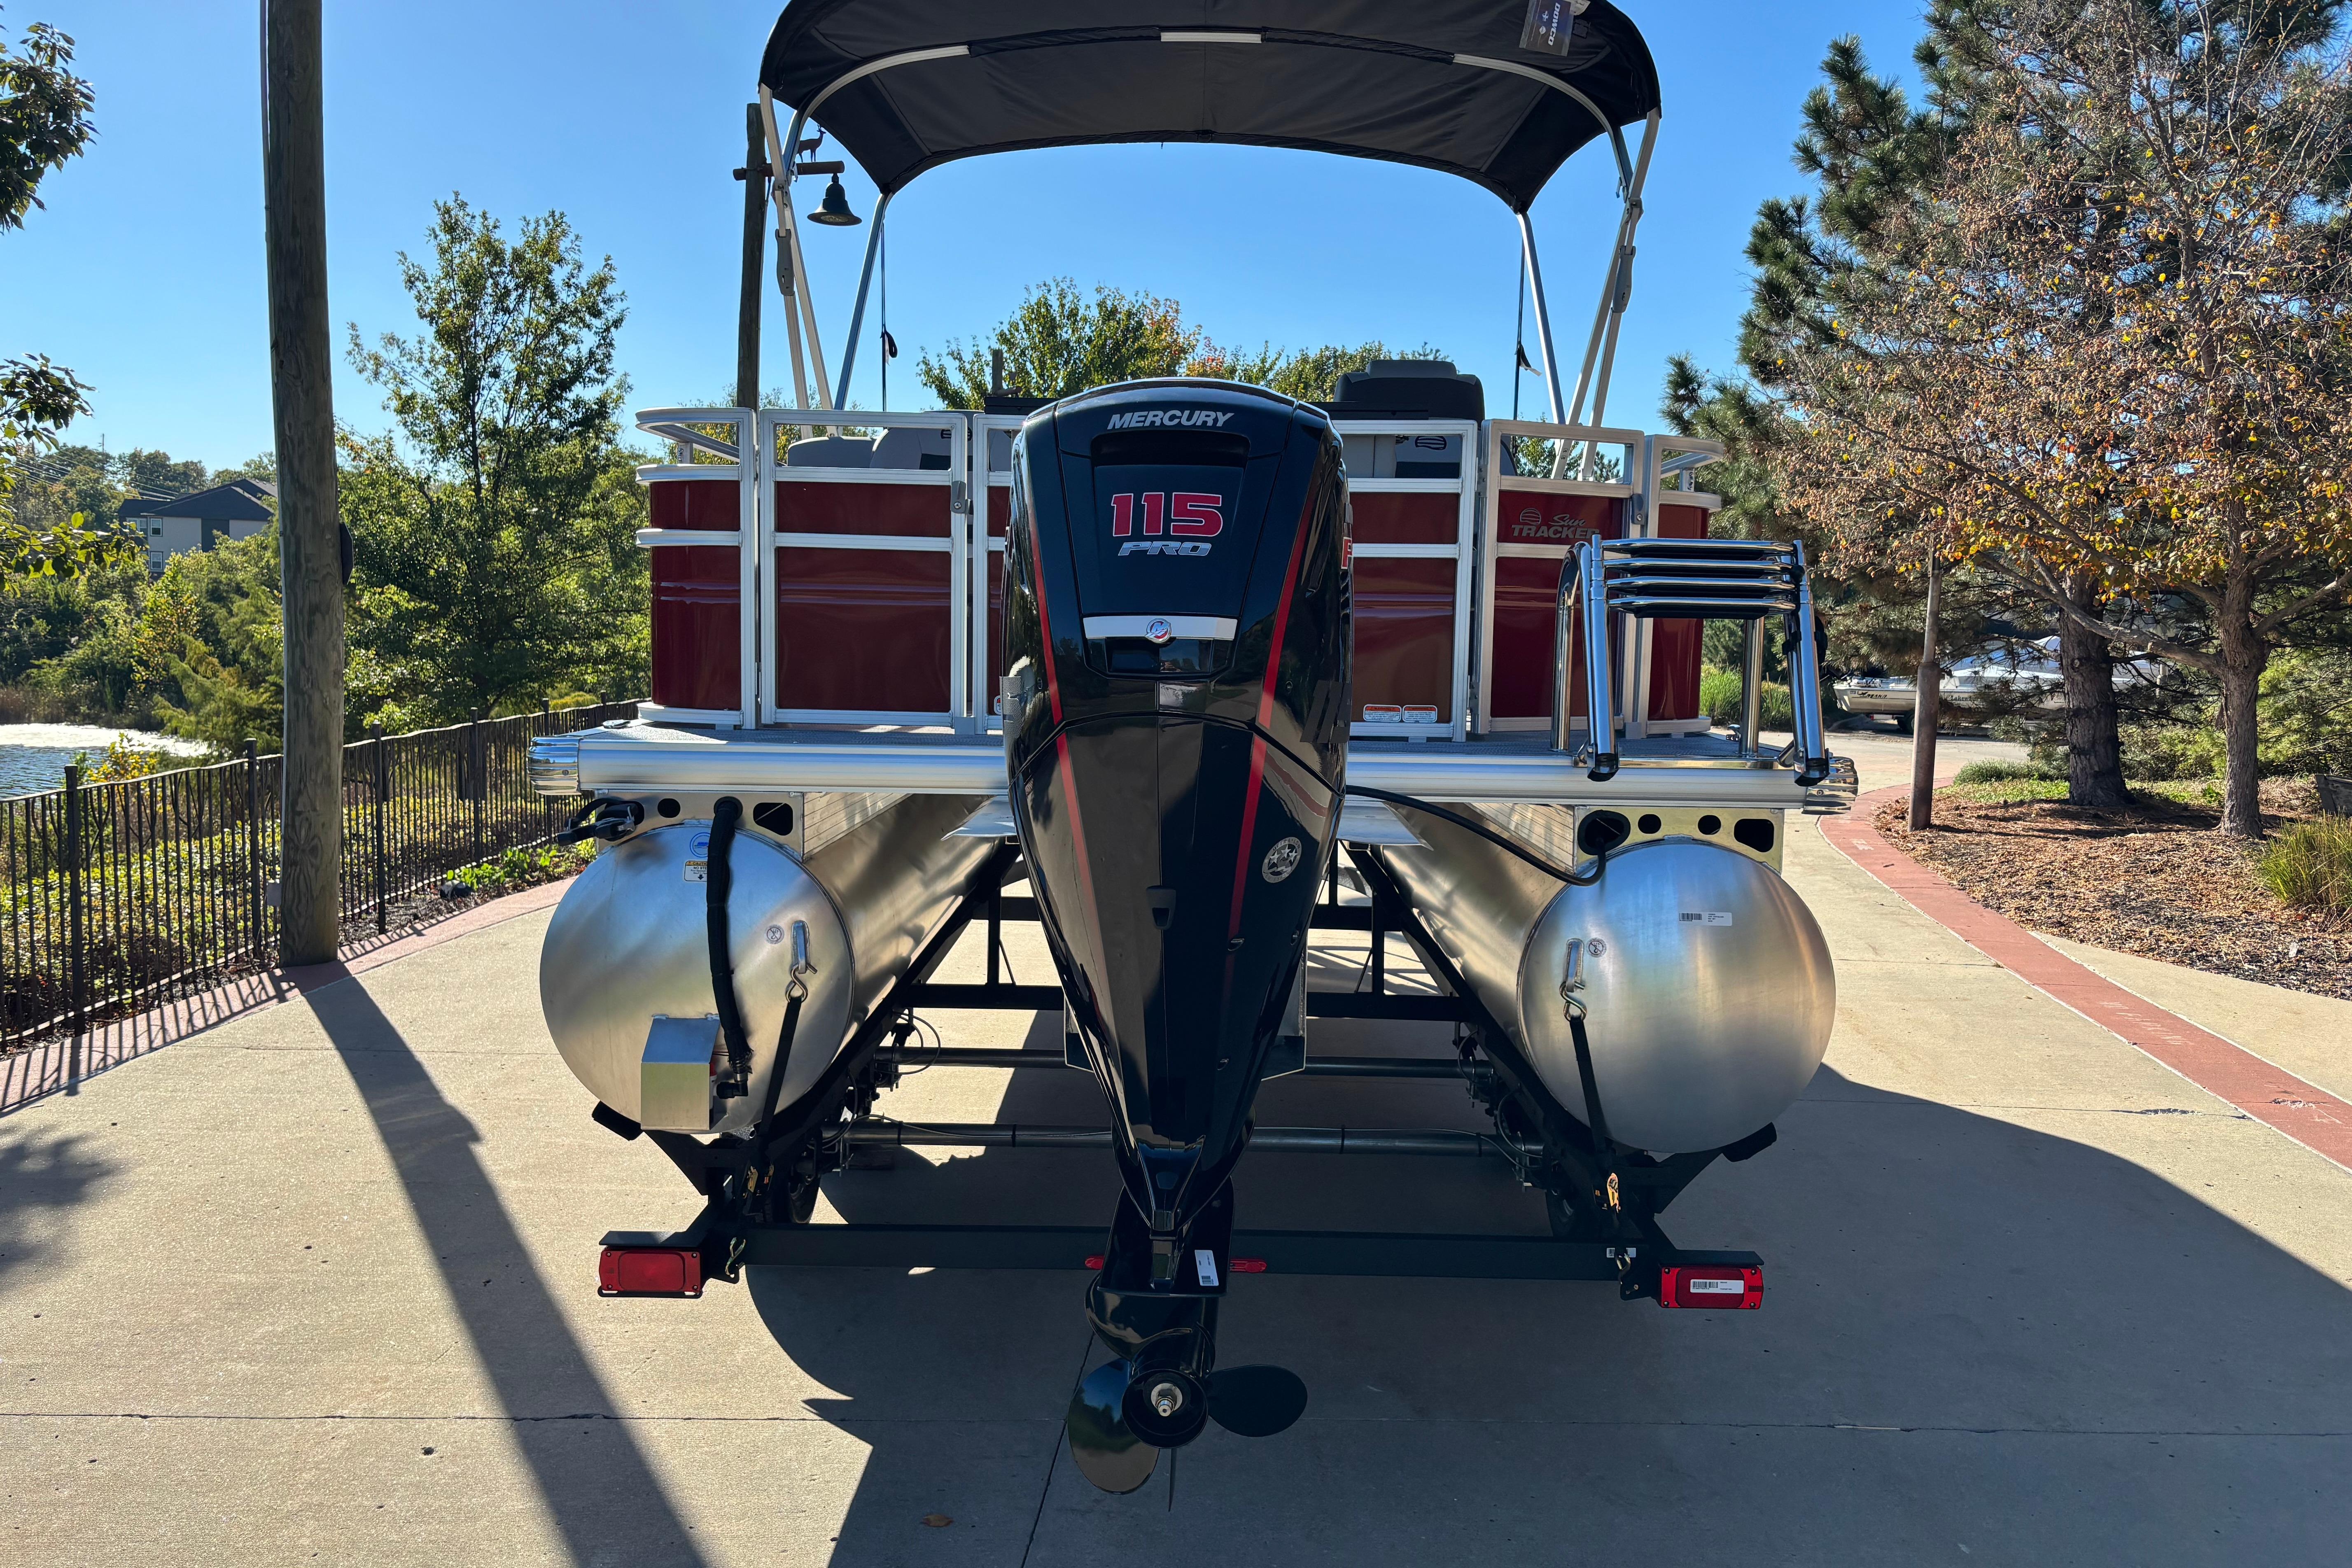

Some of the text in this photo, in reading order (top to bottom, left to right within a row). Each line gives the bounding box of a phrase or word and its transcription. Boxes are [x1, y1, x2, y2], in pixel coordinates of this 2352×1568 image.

[1548, 2, 1561, 46] DOWCO
[1107, 410, 1234, 429] MERCURY
[1111, 492, 1223, 537] 115
[1548, 514, 1585, 526] Sun
[1118, 541, 1212, 556] PRO
